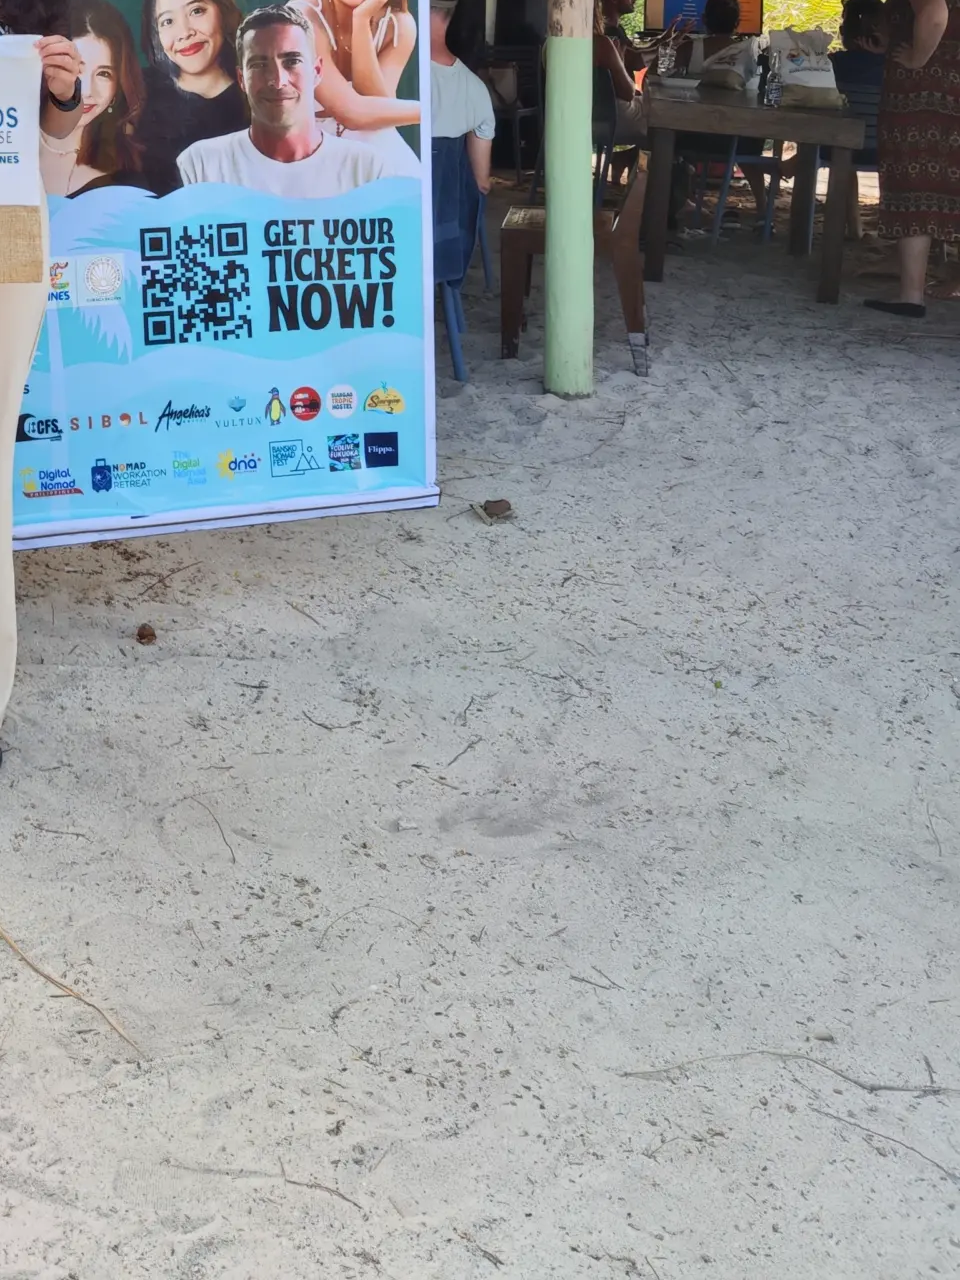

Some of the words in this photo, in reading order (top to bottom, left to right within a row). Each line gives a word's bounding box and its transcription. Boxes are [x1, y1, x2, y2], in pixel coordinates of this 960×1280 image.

[263, 220, 319, 247] GET
[322, 217, 395, 246] YOUR
[261, 246, 397, 282] TICKETS
[266, 282, 395, 333] NOW!
[154, 400, 211, 432] Angelica's
[272, 444, 297, 453] BANSKO
[272, 451, 296, 460] NOMAD
[112, 462, 146, 471] NOMAD
[172, 458, 200, 470] Digital
[228, 457, 257, 471] dna
[38, 468, 71, 481] Digital
[113, 469, 166, 480] WORKATION
[41, 479, 76, 491] Nomad
[113, 480, 151, 489] RETREAT
